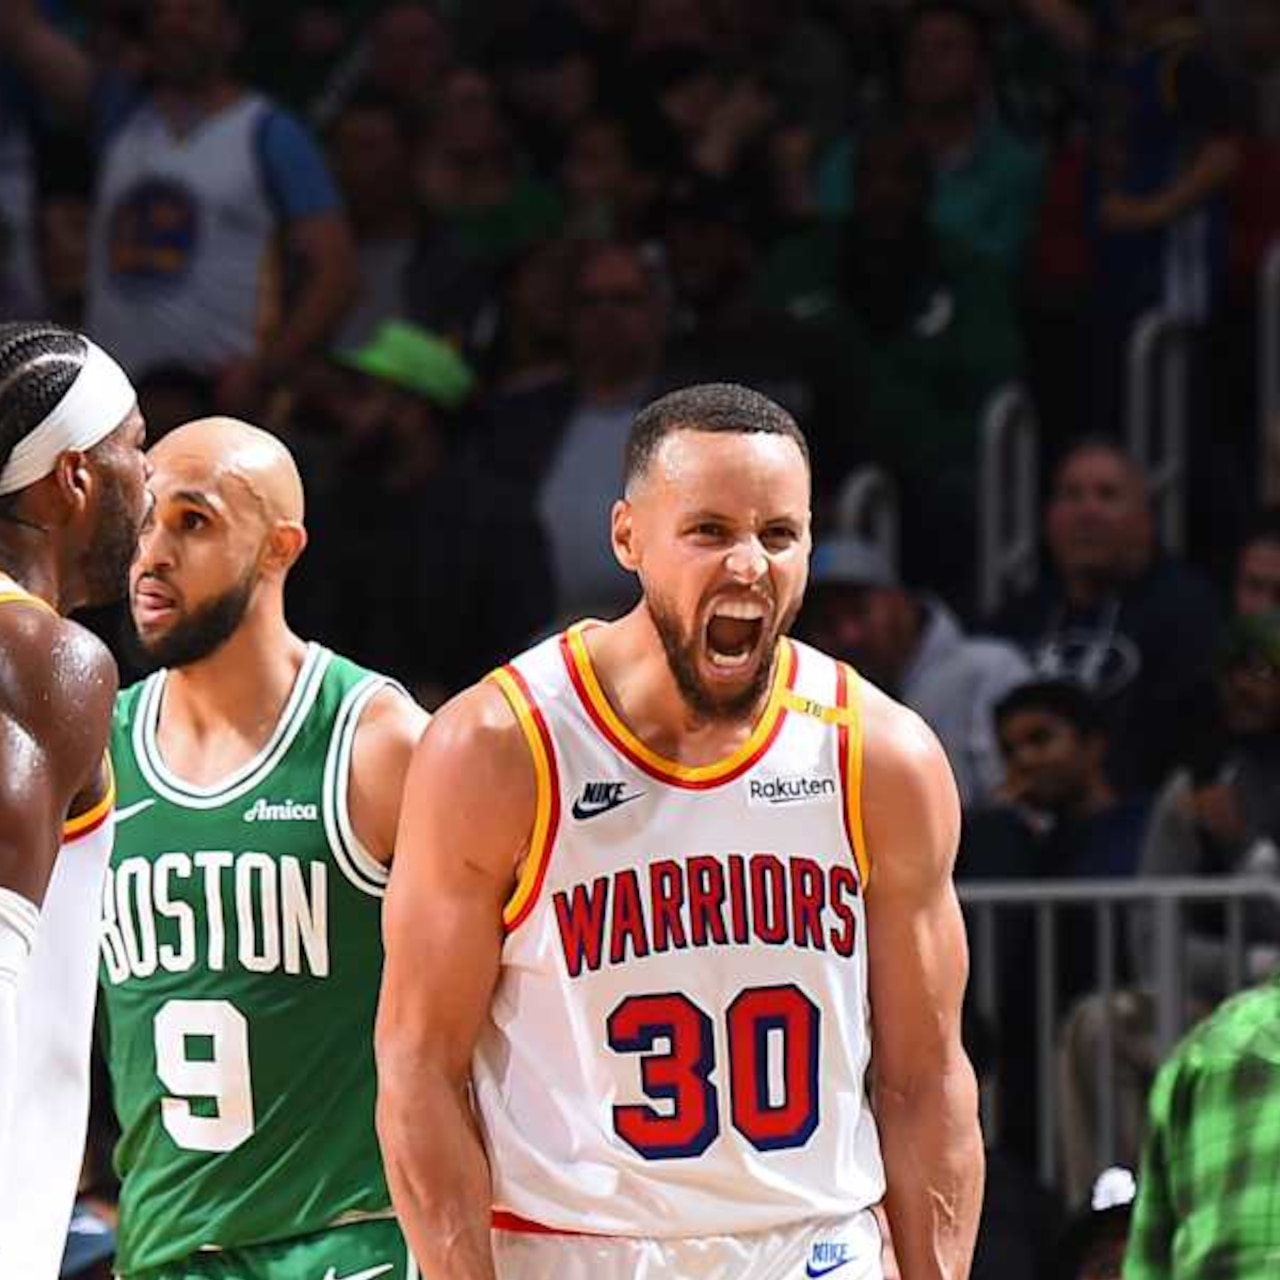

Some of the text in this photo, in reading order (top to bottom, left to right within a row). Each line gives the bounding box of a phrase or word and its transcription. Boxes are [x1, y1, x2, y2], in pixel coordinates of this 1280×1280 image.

[243, 798, 318, 822] Amica
[582, 782, 627, 804] NIKE
[750, 776, 835, 800] Rakuten
[553, 854, 859, 978] WARRIORS
[153, 999, 256, 1153] 9
[607, 983, 821, 1160] 30
